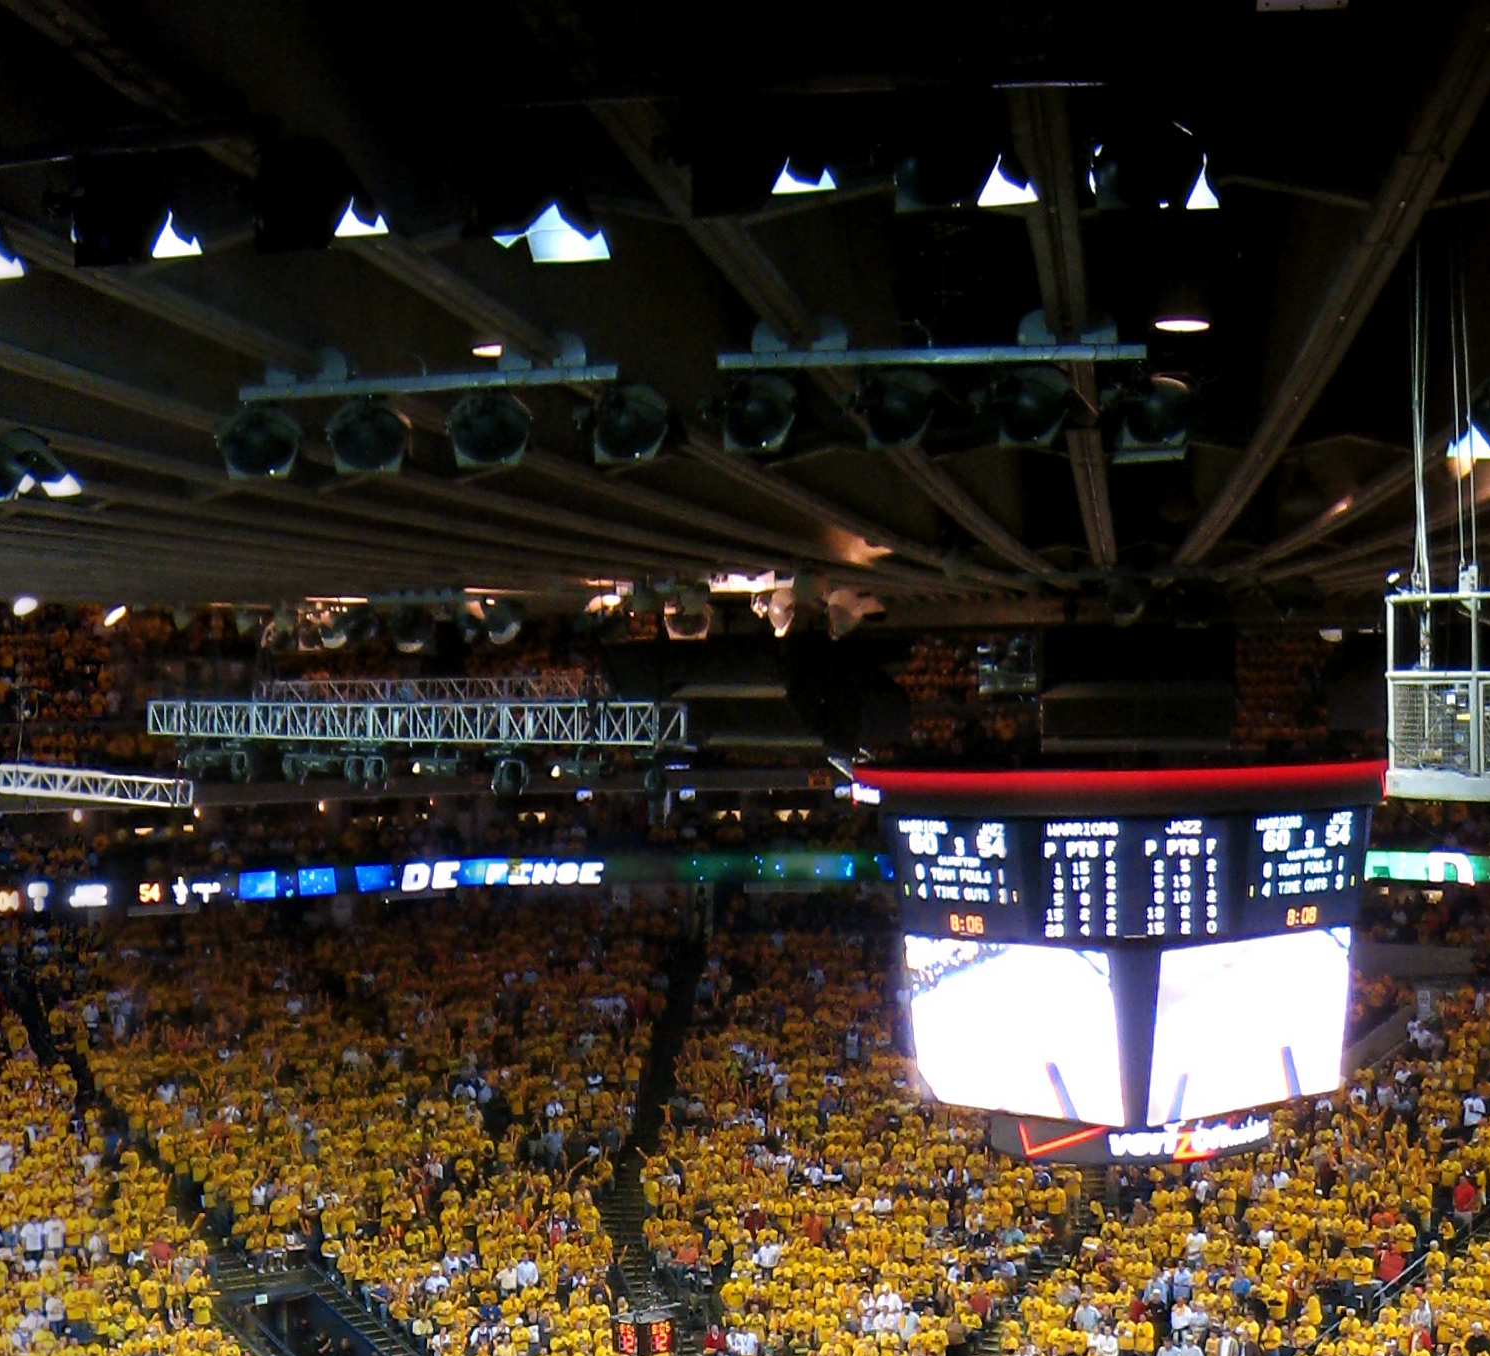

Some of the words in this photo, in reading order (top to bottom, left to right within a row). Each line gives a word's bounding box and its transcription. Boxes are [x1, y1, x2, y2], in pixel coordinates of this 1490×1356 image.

[1255, 815, 1303, 831] WARRIORS
[1329, 811, 1353, 825] JAZZ
[898, 820, 948, 834] WARRIORS
[979, 823, 1005, 837] JAZZ
[1047, 822, 1118, 836] WARRIORS
[1165, 820, 1202, 835] JAZZ
[1325, 824, 1351, 846] 54
[909, 832, 938, 854] 60
[954, 836, 965, 856] 3
[976, 834, 1007, 858] 54
[1262, 829, 1290, 852] 60
[1304, 829, 1315, 848] 3
[1044, 842, 1057, 858] P
[1065, 841, 1099, 858] PTS
[1105, 840, 1116, 857] F
[1145, 839, 1157, 857] P
[1166, 838, 1200, 856] PTS
[1206, 838, 1217, 855] F
[1055, 862, 1062, 875] 1
[1072, 861, 1090, 875] 15
[1105, 860, 1116, 874] 2
[1154, 859, 1164, 873] 2
[1179, 858, 1190, 872] 5
[1206, 858, 1217, 872] 2
[1277, 862, 1301, 876] TEAM
[1303, 859, 1332, 874] FOULS
[401, 861, 460, 892] DE
[930, 866, 957, 881] TEAM
[959, 868, 992, 884] FOULS
[1072, 876, 1090, 890] 17
[1105, 875, 1116, 890] 2
[1154, 874, 1164, 888] 5
[1208, 873, 1215, 887] 1
[139, 882, 160, 903] 54
[918, 882, 927, 899] 4
[933, 885, 960, 900] TIME
[963, 887, 990, 902] OUTS
[1261, 882, 1271, 898] 4
[1277, 880, 1301, 895] TIME
[1304, 877, 1328, 892] OUTS
[1053, 892, 1064, 906] 5
[1105, 891, 1116, 905] 2
[1173, 889, 1191, 904] 10
[1206, 889, 1217, 903] 2
[1046, 908, 1064, 922] 15
[1079, 907, 1090, 922] 2
[1105, 906, 1116, 920] 2
[1180, 905, 1190, 919] 2
[949, 914, 984, 934] 8:06
[1080, 923, 1090, 937] 4
[1105, 922, 1116, 936] 2
[1147, 921, 1165, 935] 15
[1180, 920, 1190, 935] 2
[1206, 920, 1217, 934] 0
[654, 1333, 668, 1352] 12
